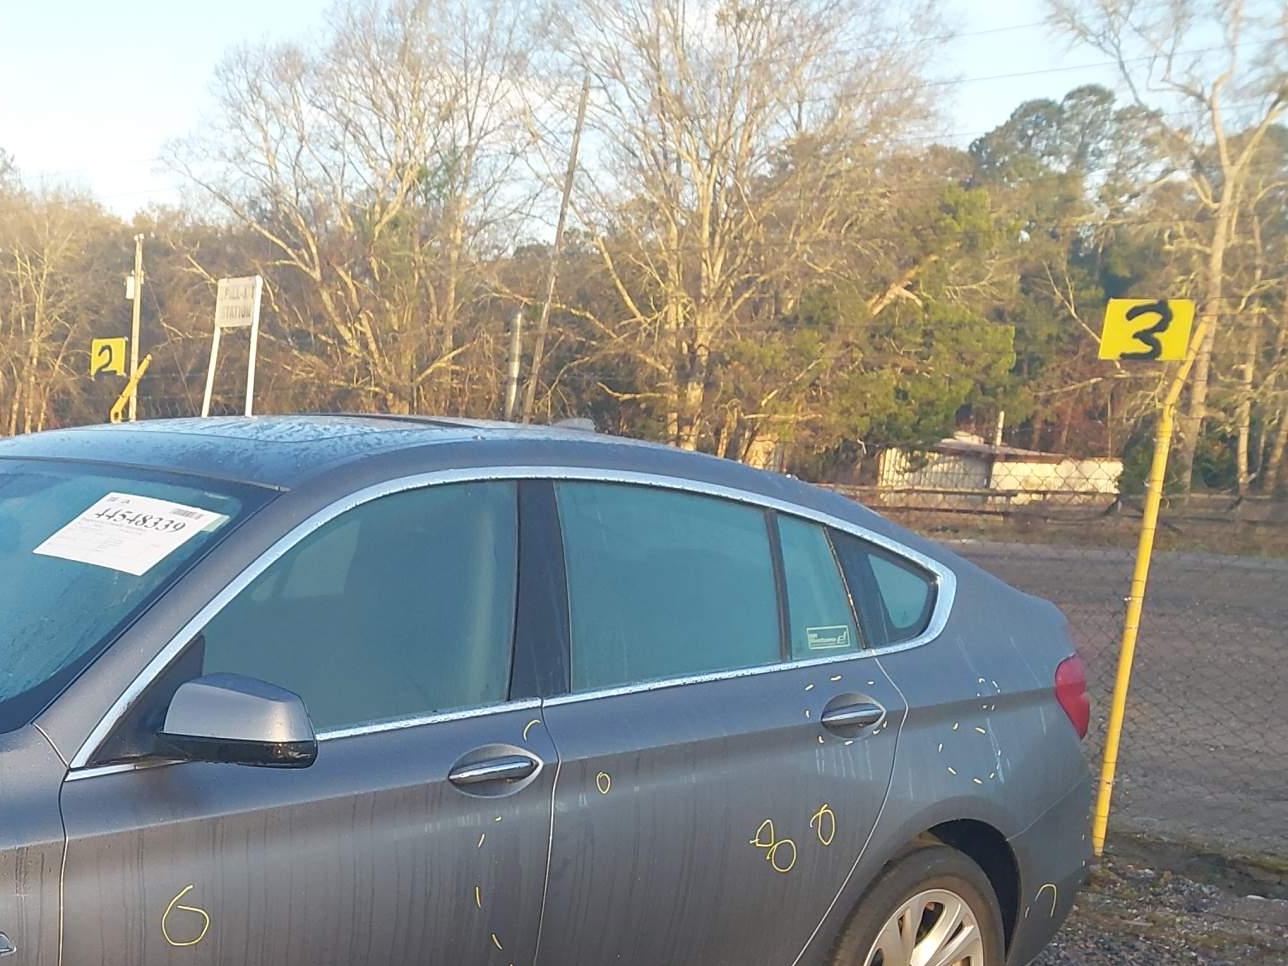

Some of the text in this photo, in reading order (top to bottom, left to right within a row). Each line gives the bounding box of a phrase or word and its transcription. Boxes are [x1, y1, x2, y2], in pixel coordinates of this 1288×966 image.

[1119, 298, 1174, 362] 3
[93, 344, 118, 377] 2
[95, 507, 187, 533] 44548339
